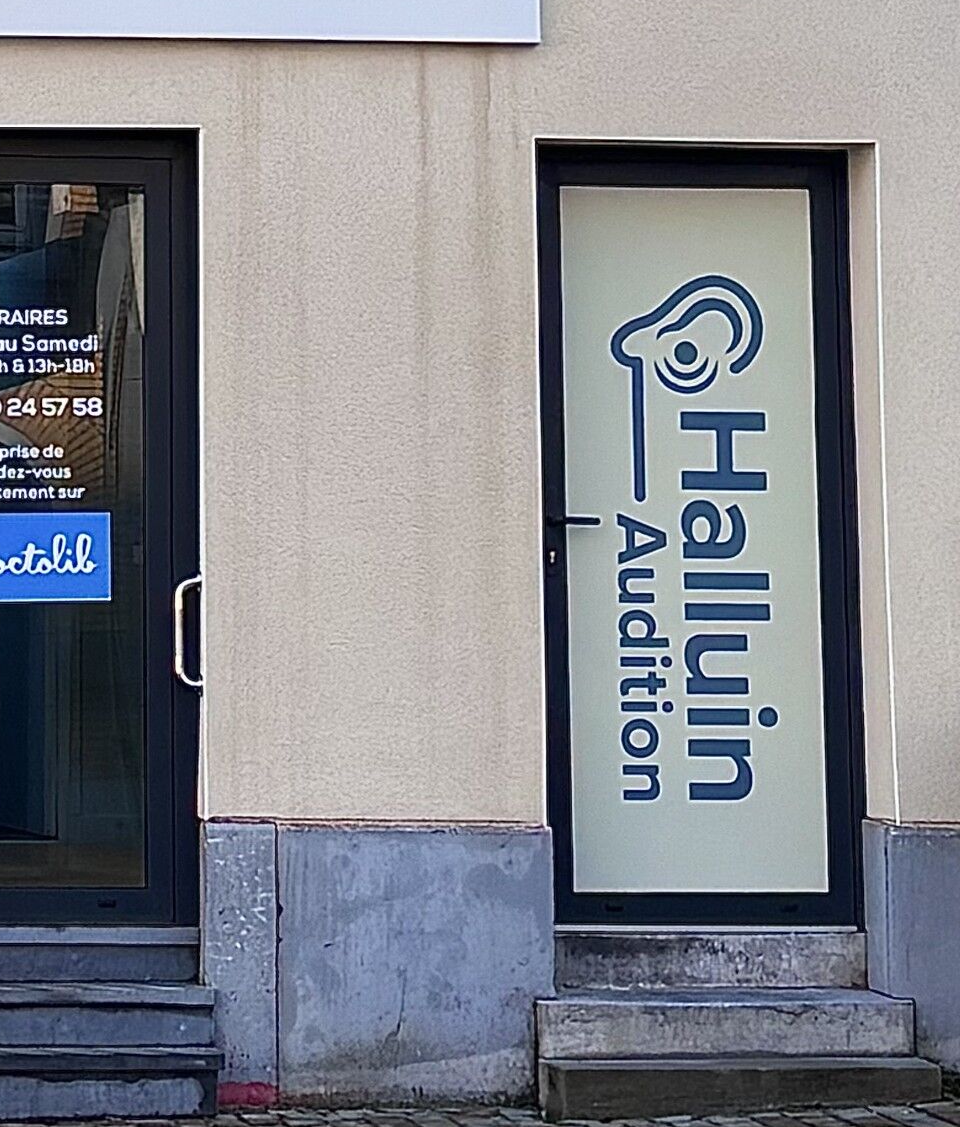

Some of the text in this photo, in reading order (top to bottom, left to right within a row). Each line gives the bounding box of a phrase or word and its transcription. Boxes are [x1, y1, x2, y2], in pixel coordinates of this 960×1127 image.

[21, 334, 99, 352] Samedi
[12, 358, 25, 374] &
[27, 358, 95, 374] 13h-18h
[7, 397, 37, 417] 24
[41, 397, 69, 417] 57
[72, 397, 103, 417] 58
[42, 443, 64, 459] de
[58, 487, 86, 500] sur
[679, 410, 779, 802] Halluin
[615, 512, 674, 802] Audition
